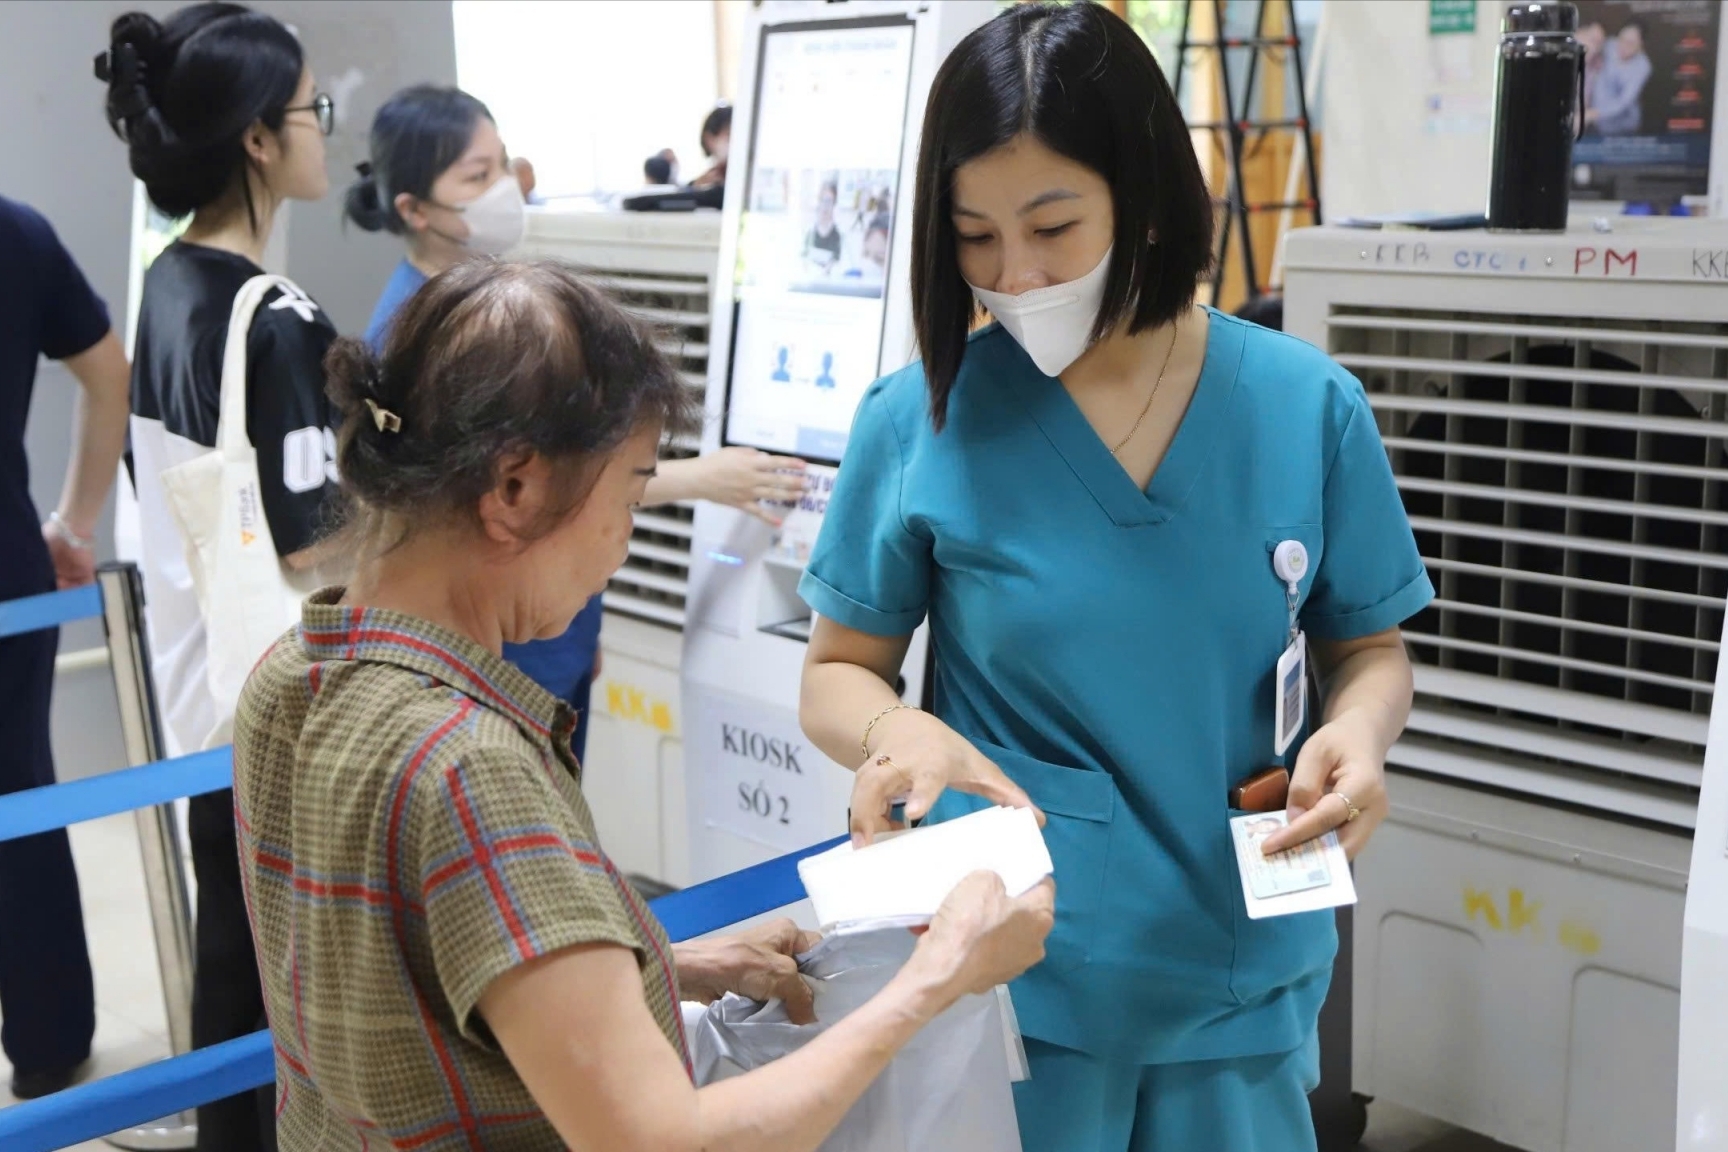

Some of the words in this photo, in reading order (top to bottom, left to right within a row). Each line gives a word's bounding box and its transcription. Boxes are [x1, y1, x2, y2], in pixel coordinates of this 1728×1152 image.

[1574, 247, 1637, 275] PM
[1692, 247, 1728, 278] KK
[721, 722, 804, 775] KIOSK
[779, 795, 790, 826] 2
